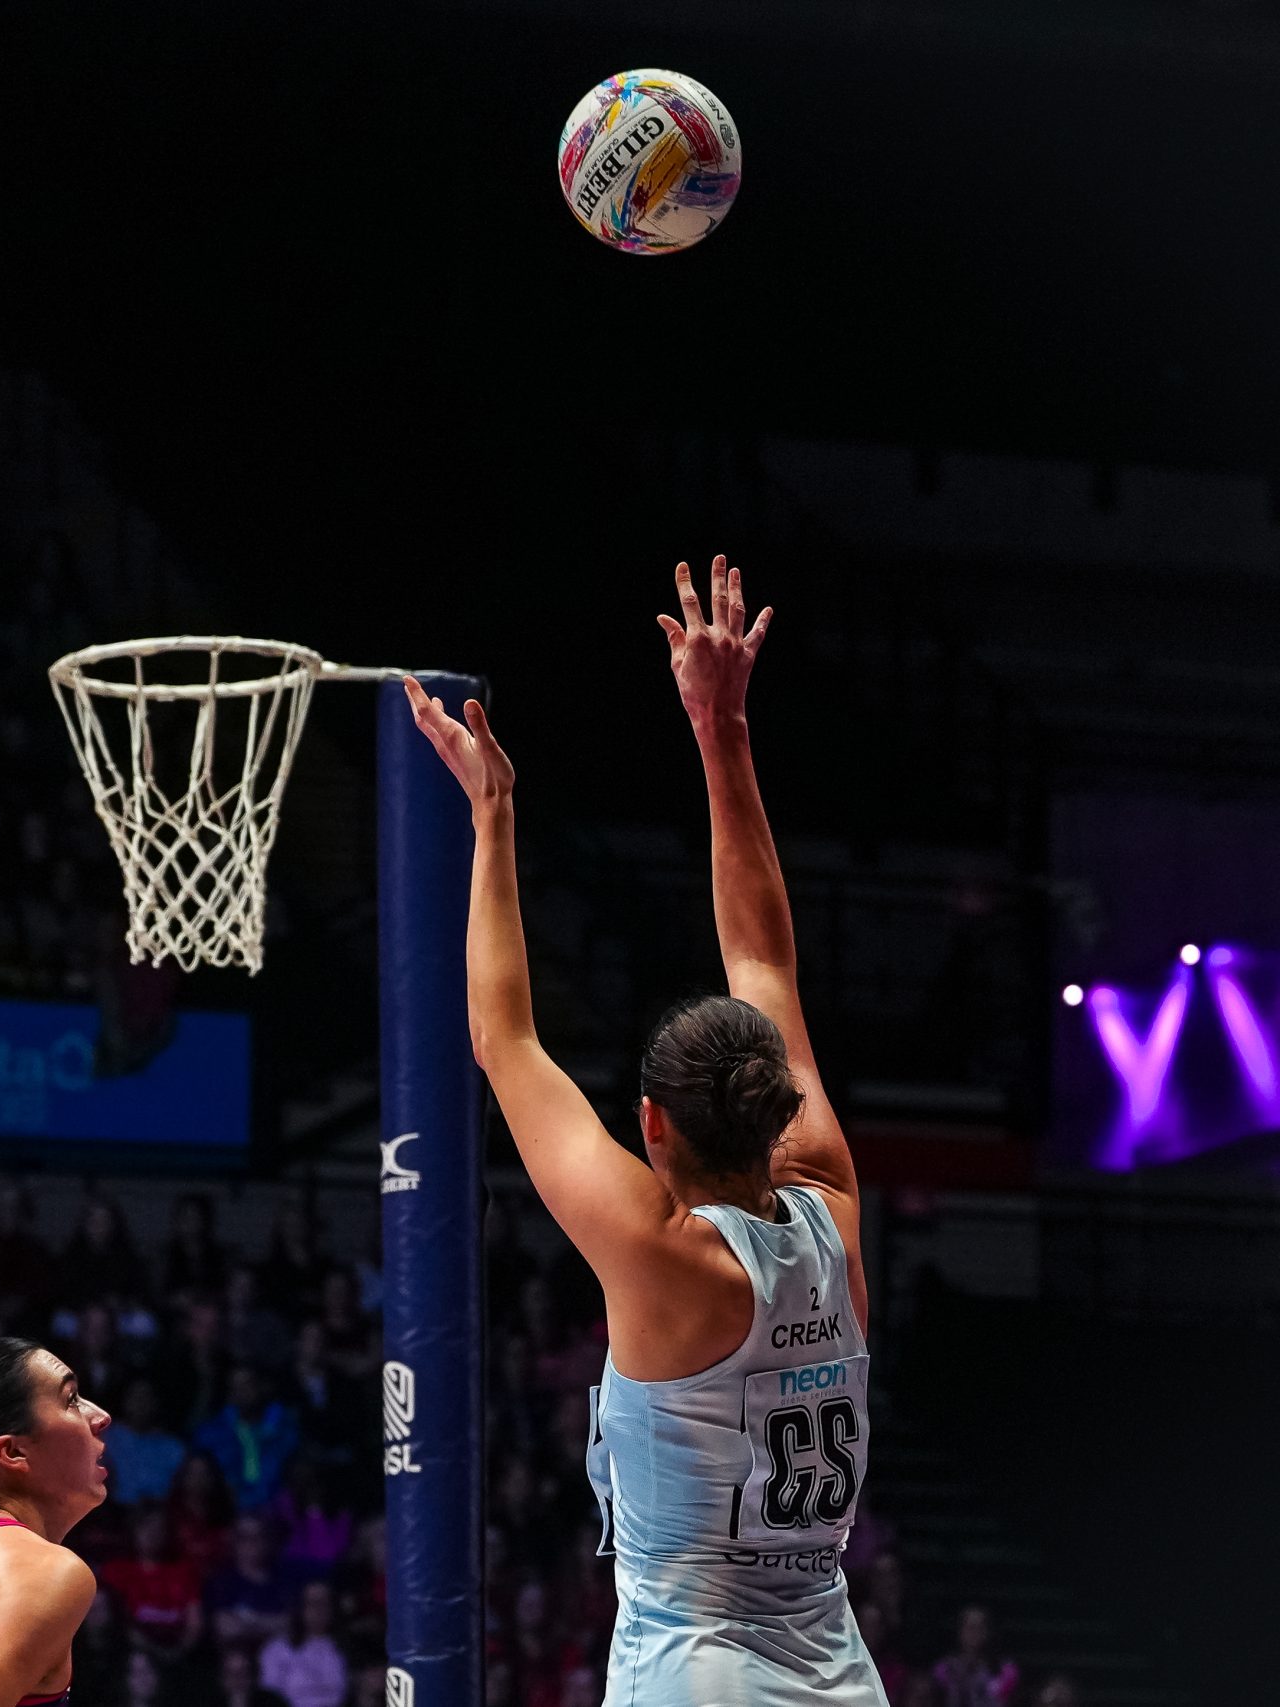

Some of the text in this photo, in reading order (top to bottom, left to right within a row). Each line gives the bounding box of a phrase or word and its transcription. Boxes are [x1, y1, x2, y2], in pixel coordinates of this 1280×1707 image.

[577, 116, 665, 220] GILBERT
[810, 1286, 821, 1312] 2
[771, 1312, 842, 1350] CREAK
[780, 1361, 847, 1396] neon
[761, 1396, 859, 1530] GS
